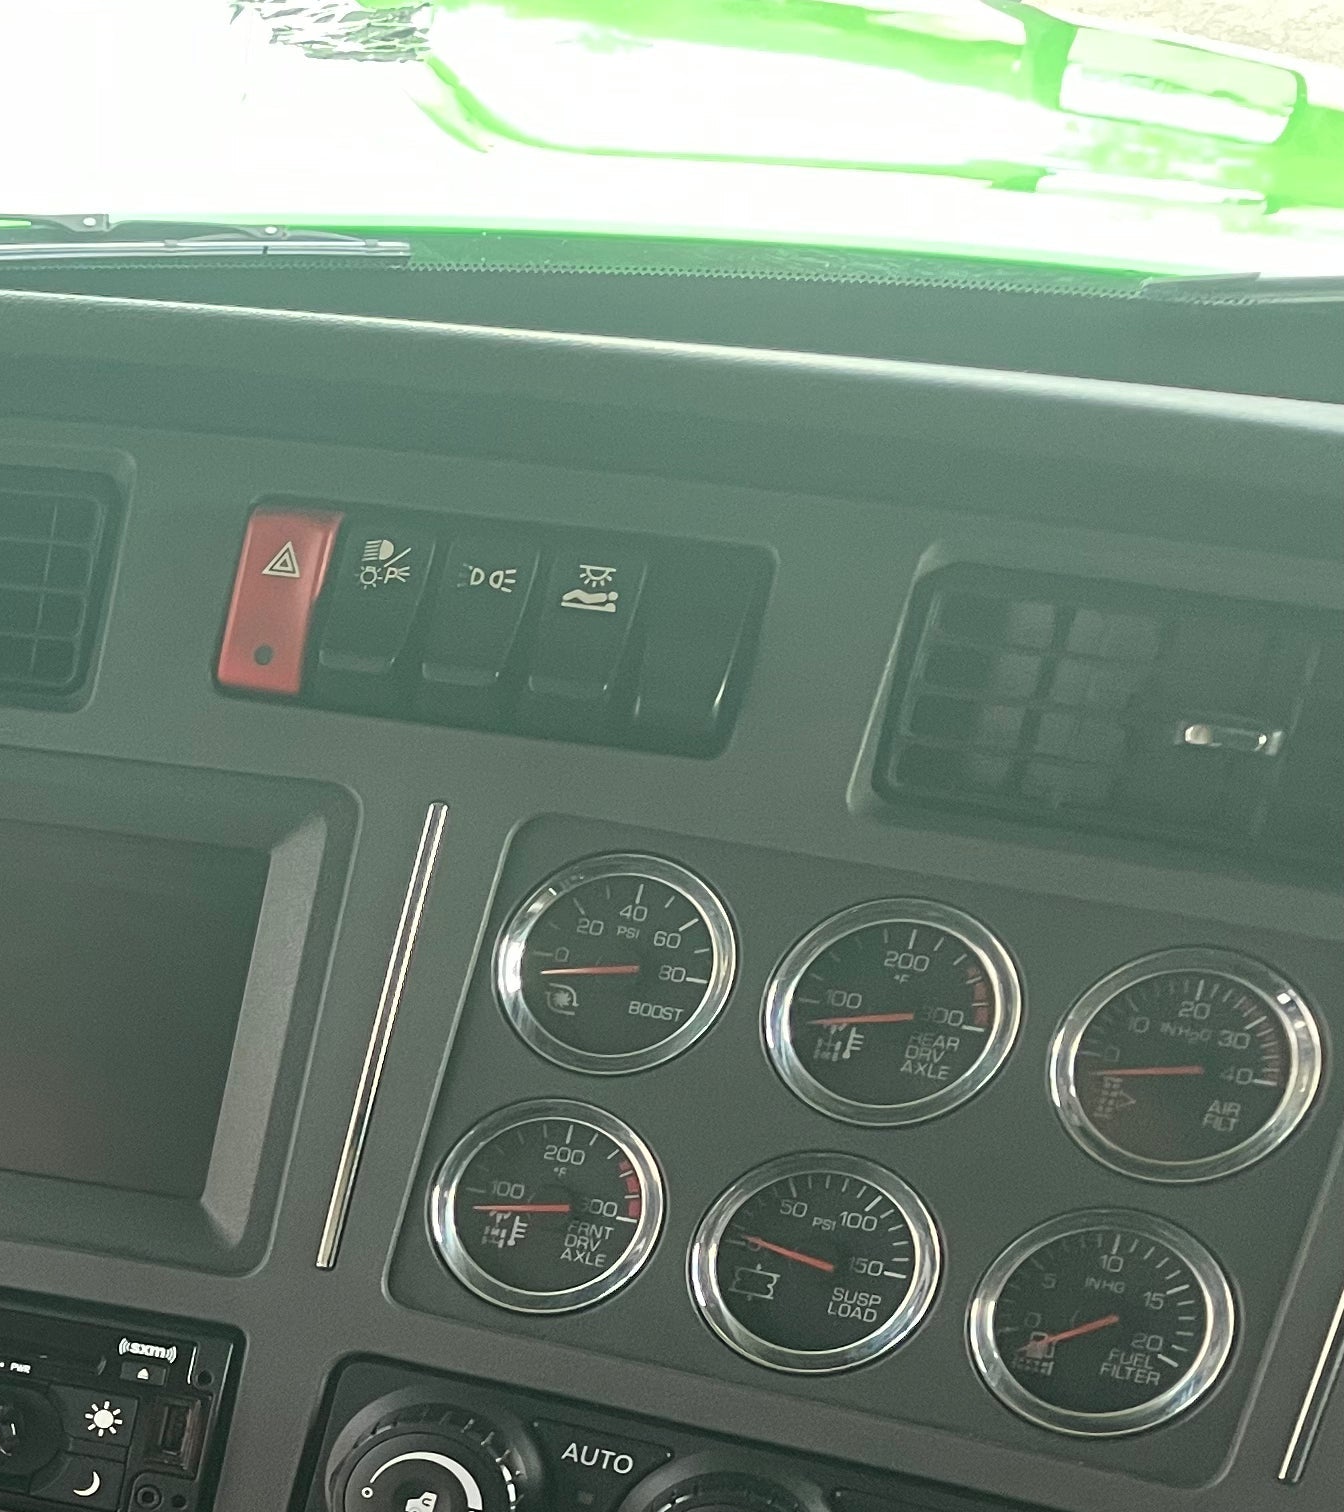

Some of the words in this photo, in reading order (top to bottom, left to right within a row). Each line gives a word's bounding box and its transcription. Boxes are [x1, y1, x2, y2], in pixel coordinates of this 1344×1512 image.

[619, 905, 648, 922] 40
[577, 919, 604, 936] 20
[617, 927, 640, 939] PSI
[653, 931, 681, 949] 60
[555, 947, 569, 962] 0
[884, 951, 930, 972] 200
[826, 990, 862, 1009] 100
[628, 1001, 684, 1022] BOOST
[1178, 1002, 1211, 1020] 20
[912, 1033, 960, 1052] REAR
[1218, 1030, 1250, 1049] 30
[904, 1046, 945, 1063] DRV
[900, 1062, 951, 1080] AXLE
[1208, 1100, 1241, 1116] AIR
[544, 1145, 585, 1165] 200
[493, 1181, 525, 1199] 100
[780, 1200, 808, 1218] 50
[567, 1220, 614, 1240] FRNT
[812, 1216, 836, 1231] PSI
[840, 1211, 878, 1231] 100
[564, 1234, 601, 1251] DRV
[560, 1249, 607, 1267] AXLE
[850, 1257, 883, 1276] 150
[1100, 1254, 1124, 1272] 10
[832, 1287, 882, 1307] SUSP
[1143, 1291, 1166, 1310] 15
[827, 1302, 877, 1322] LOAD
[1131, 1335, 1162, 1351] 20
[10, 1362, 31, 1374] PWR
[1108, 1351, 1154, 1370] FUEL
[1100, 1363, 1160, 1385] FILTER
[561, 1442, 634, 1475] AUTO
